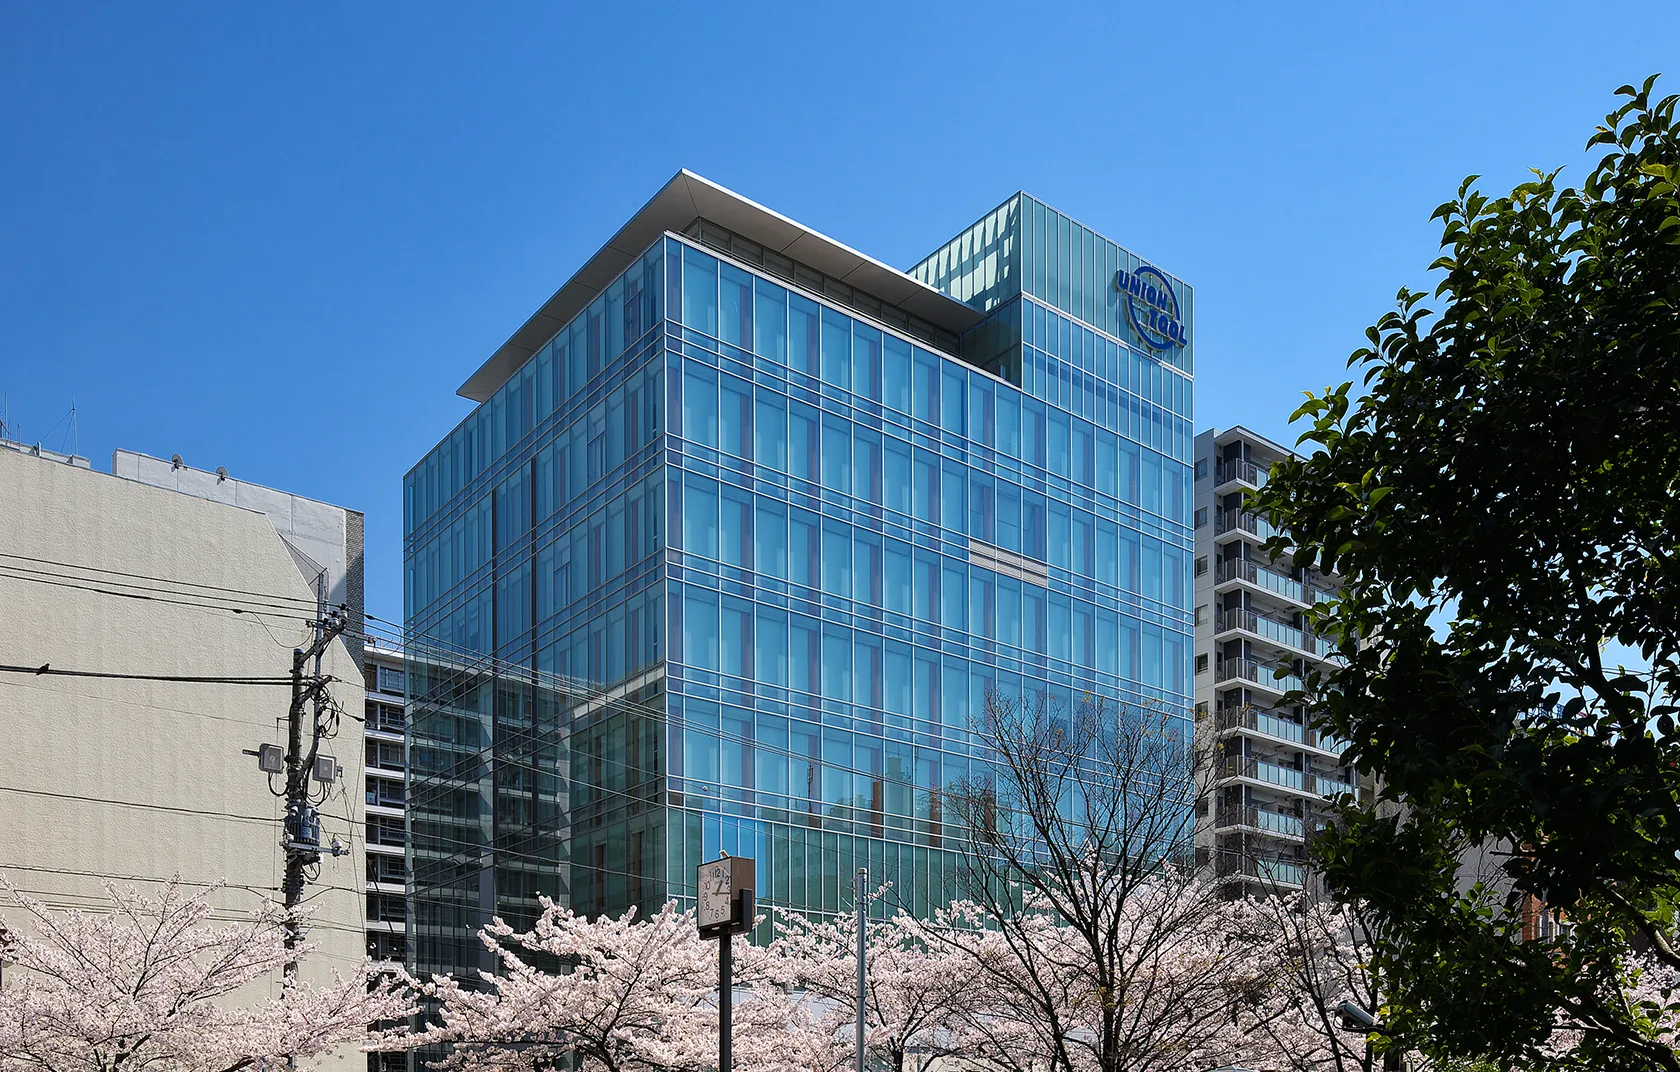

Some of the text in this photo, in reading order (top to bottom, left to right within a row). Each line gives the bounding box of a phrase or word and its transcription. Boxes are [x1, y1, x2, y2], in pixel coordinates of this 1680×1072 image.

[1117, 269, 1168, 311] UNION
[1149, 308, 1188, 346] TOOL
[709, 871, 714, 881] 11
[715, 868, 720, 878] 12
[725, 875, 729, 885] 2
[704, 881, 710, 890] 10
[704, 892, 708, 901] 9
[725, 896, 729, 905] 4
[706, 901, 709, 910] 8
[721, 906, 725, 914] 5
[710, 909, 714, 917] 7
[715, 910, 719, 918] 6
